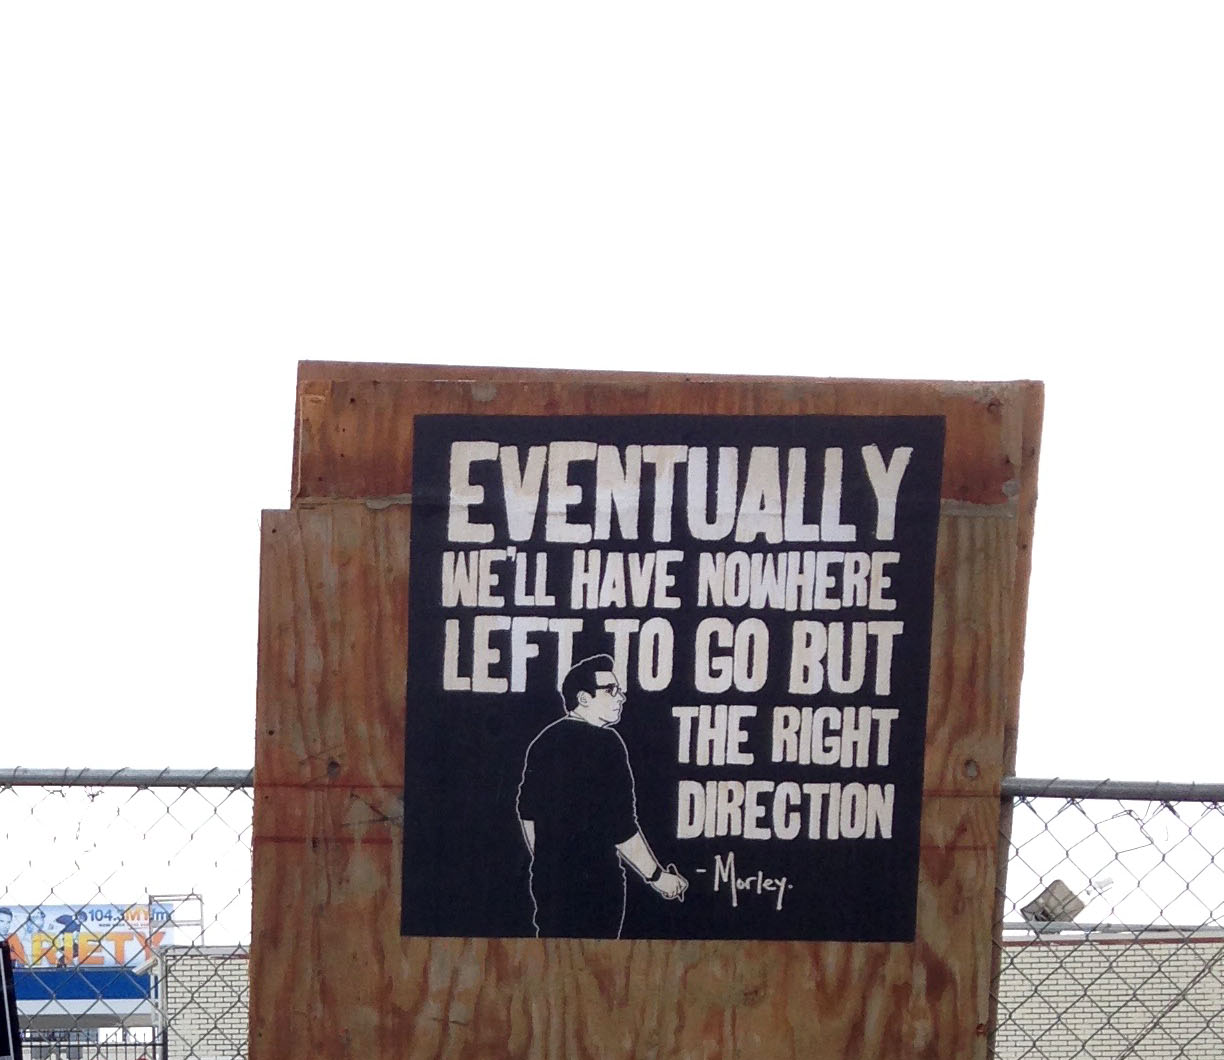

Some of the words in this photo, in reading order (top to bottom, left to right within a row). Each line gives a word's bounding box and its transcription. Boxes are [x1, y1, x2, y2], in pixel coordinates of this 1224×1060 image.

[447, 440, 914, 544] EVENTUALLY
[441, 547, 556, 609] WE'LL
[570, 549, 684, 610] HAVE
[697, 551, 901, 611] NOWHERE
[442, 615, 582, 694] LEFT
[604, 617, 675, 693] TO
[694, 618, 770, 694] GO
[788, 620, 904, 696] BUT
[671, 705, 757, 766] THE
[772, 705, 900, 767] RIGHT
[676, 780, 896, 841] DIRECTION
